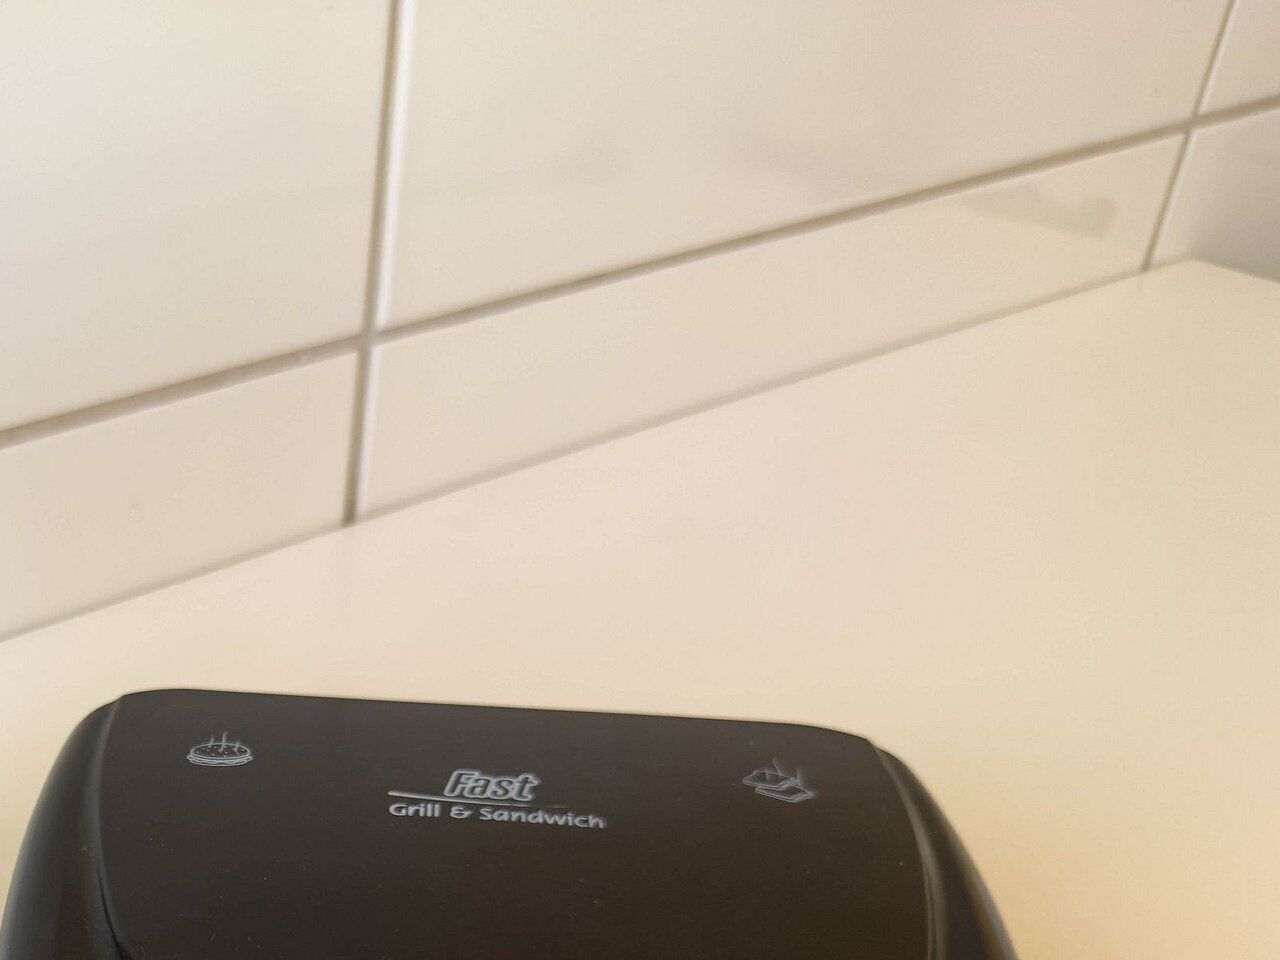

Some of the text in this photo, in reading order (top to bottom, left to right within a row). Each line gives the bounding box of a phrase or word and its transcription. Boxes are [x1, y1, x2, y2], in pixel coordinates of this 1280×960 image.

[443, 768, 541, 801] Fast
[388, 802, 608, 829] Grill & Sandwich
